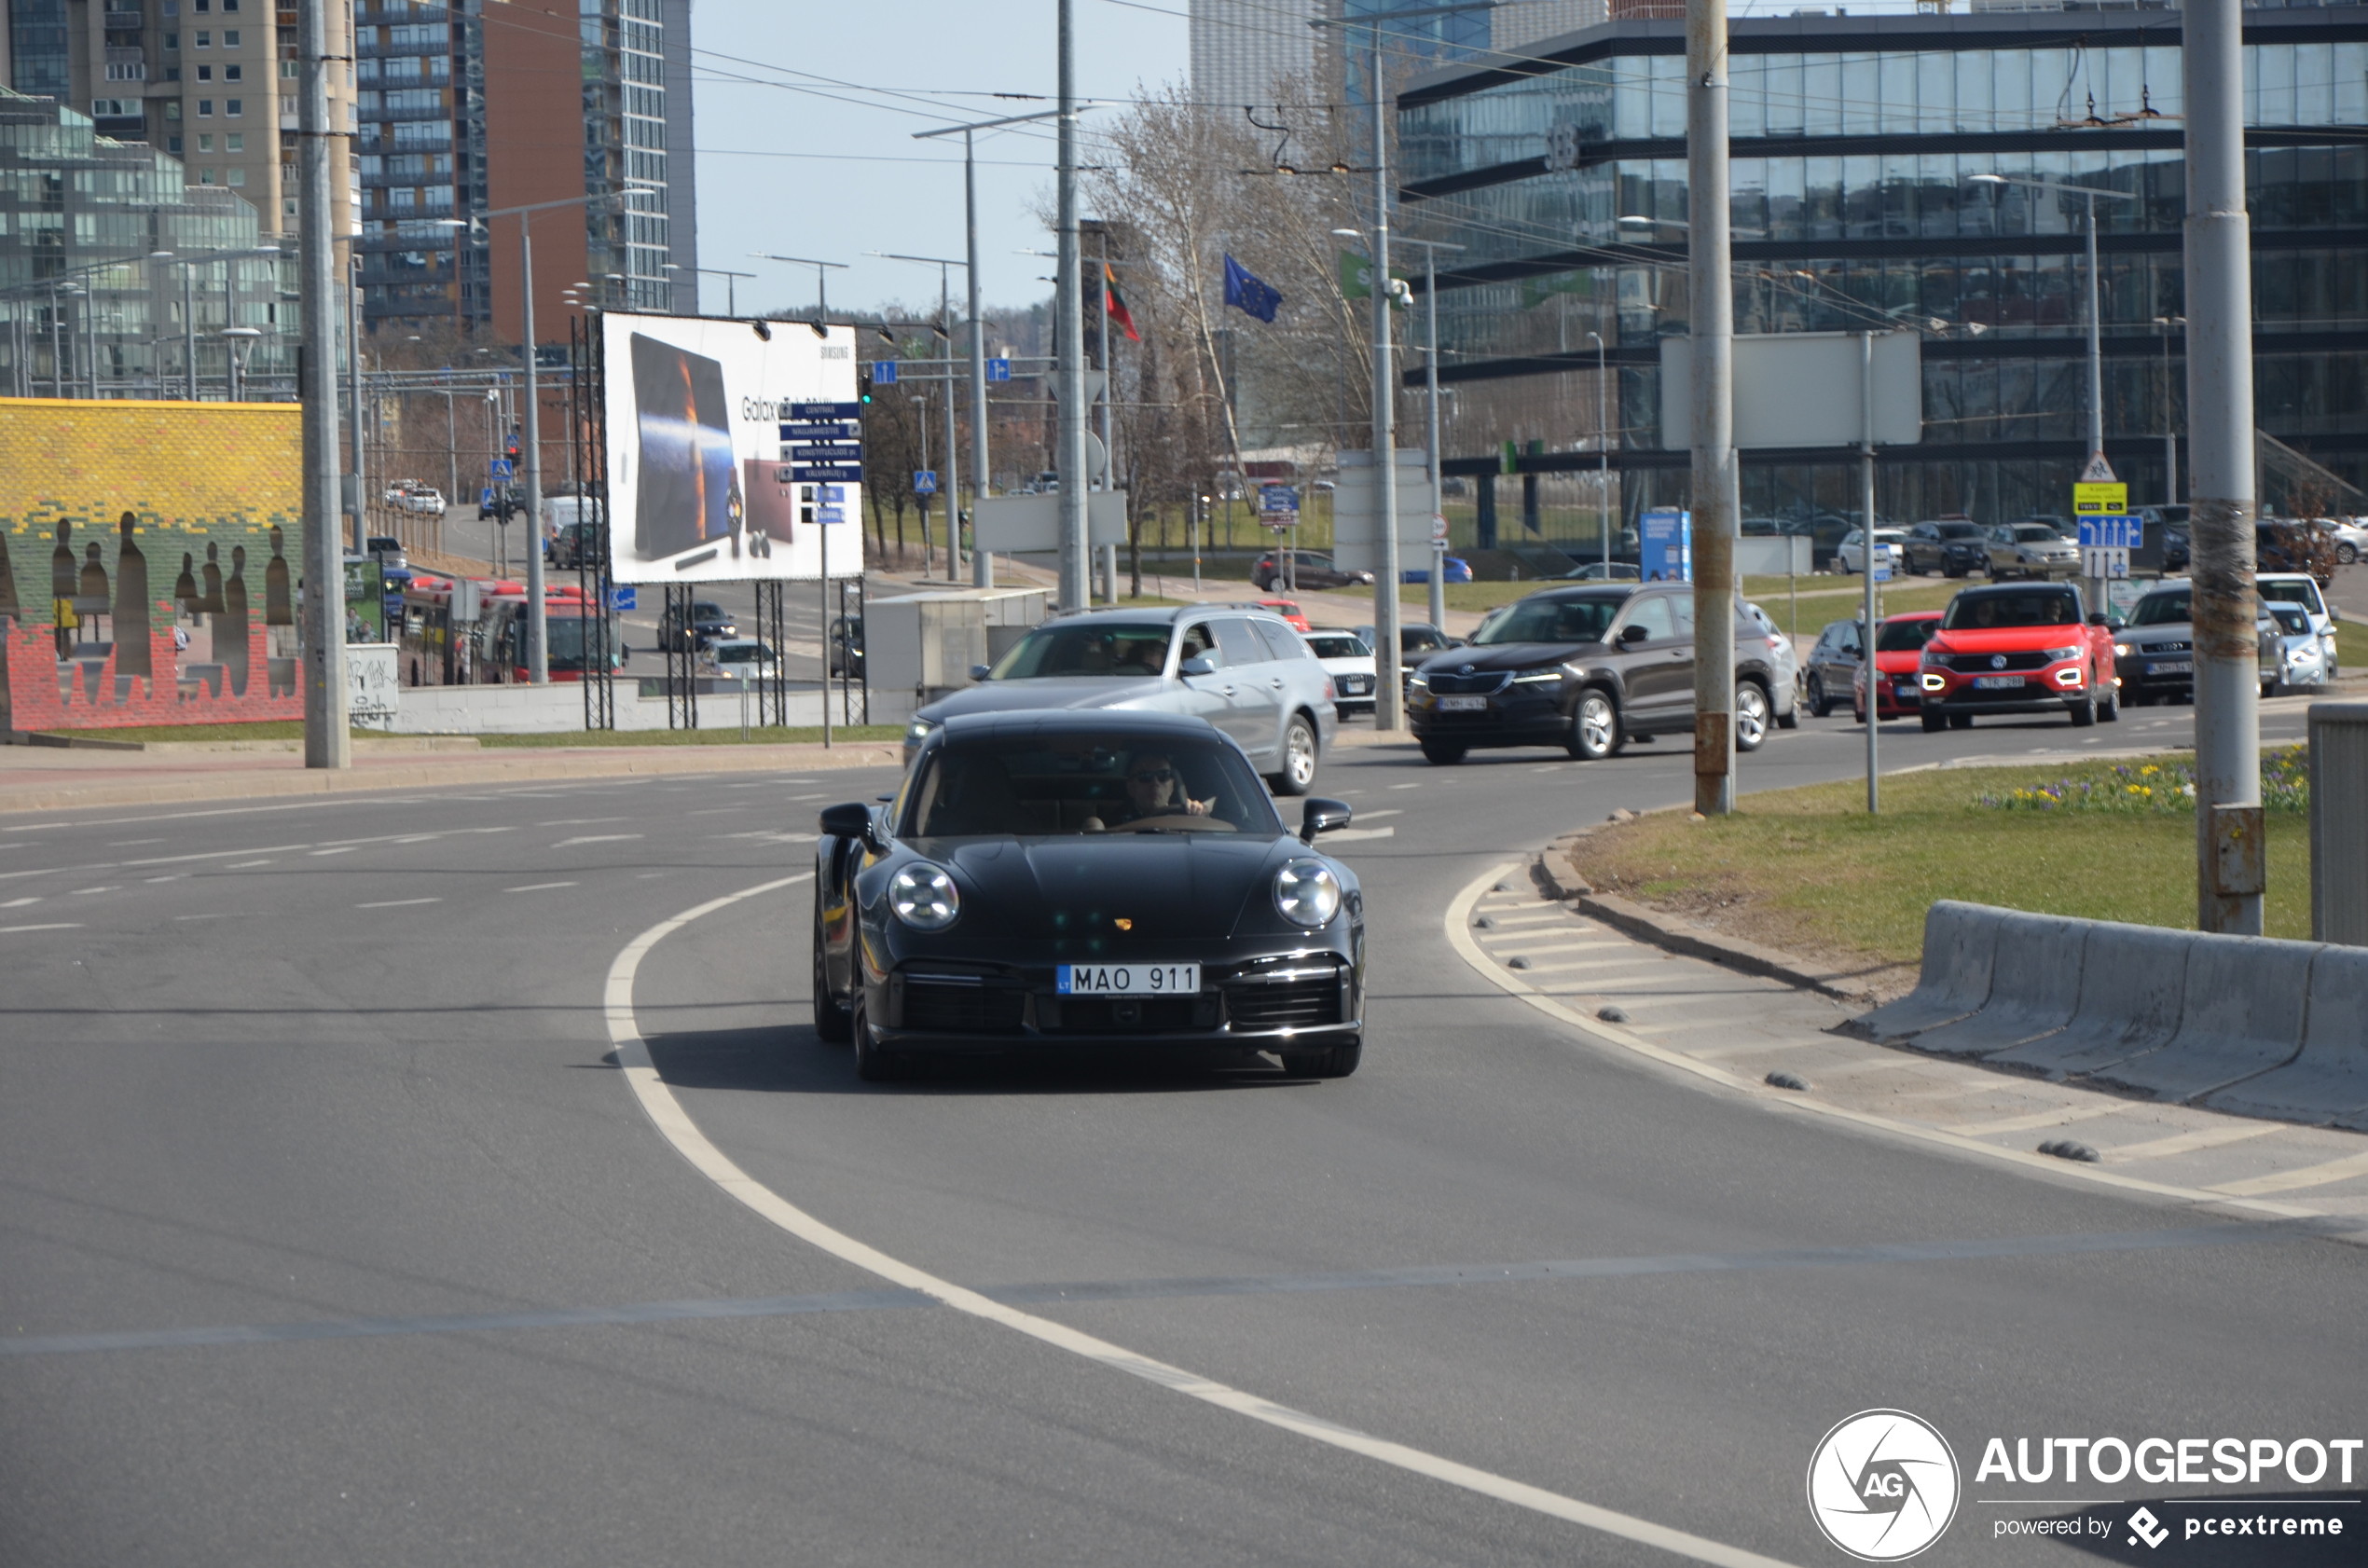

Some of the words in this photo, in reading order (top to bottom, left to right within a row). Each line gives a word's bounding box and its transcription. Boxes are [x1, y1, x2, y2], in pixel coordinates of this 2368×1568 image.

[820, 346, 848, 360] SAMSUNG
[805, 406, 835, 415] CENTRAS
[792, 426, 840, 435] NAUJAMIESTIS
[797, 447, 847, 457] KONSTITUCIJOS
[1075, 968, 1130, 990] MAO
[1150, 967, 1192, 990] 911
